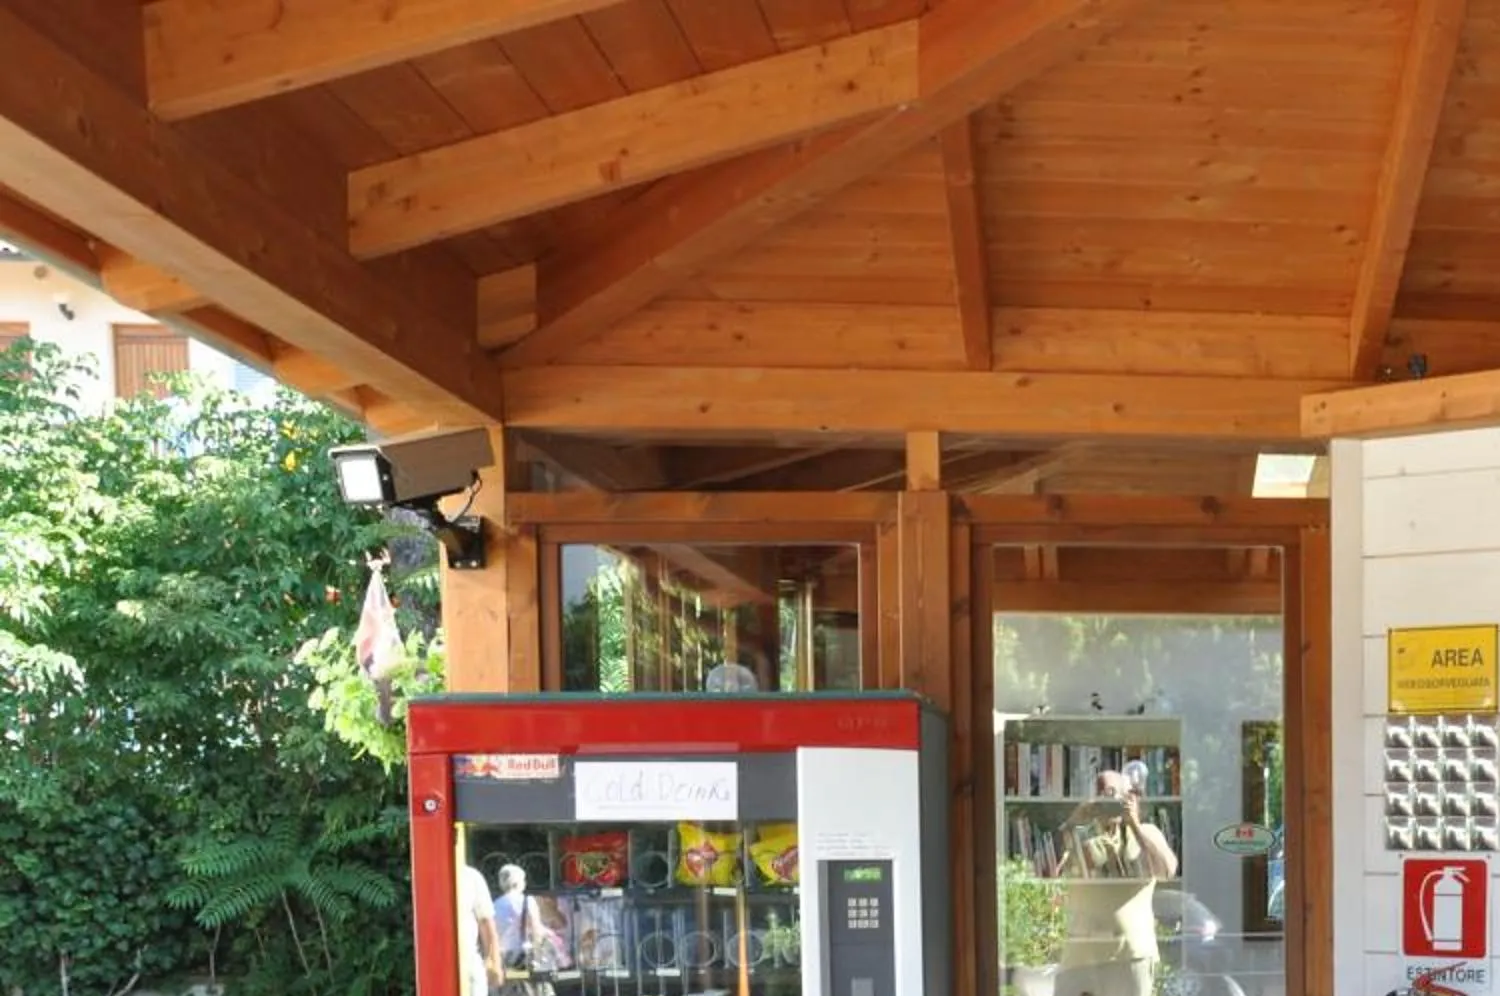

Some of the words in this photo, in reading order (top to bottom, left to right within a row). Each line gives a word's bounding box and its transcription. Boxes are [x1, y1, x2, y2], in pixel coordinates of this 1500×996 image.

[1431, 647, 1484, 668] AREA
[508, 757, 530, 771] Red
[532, 757, 557, 771] Bull
